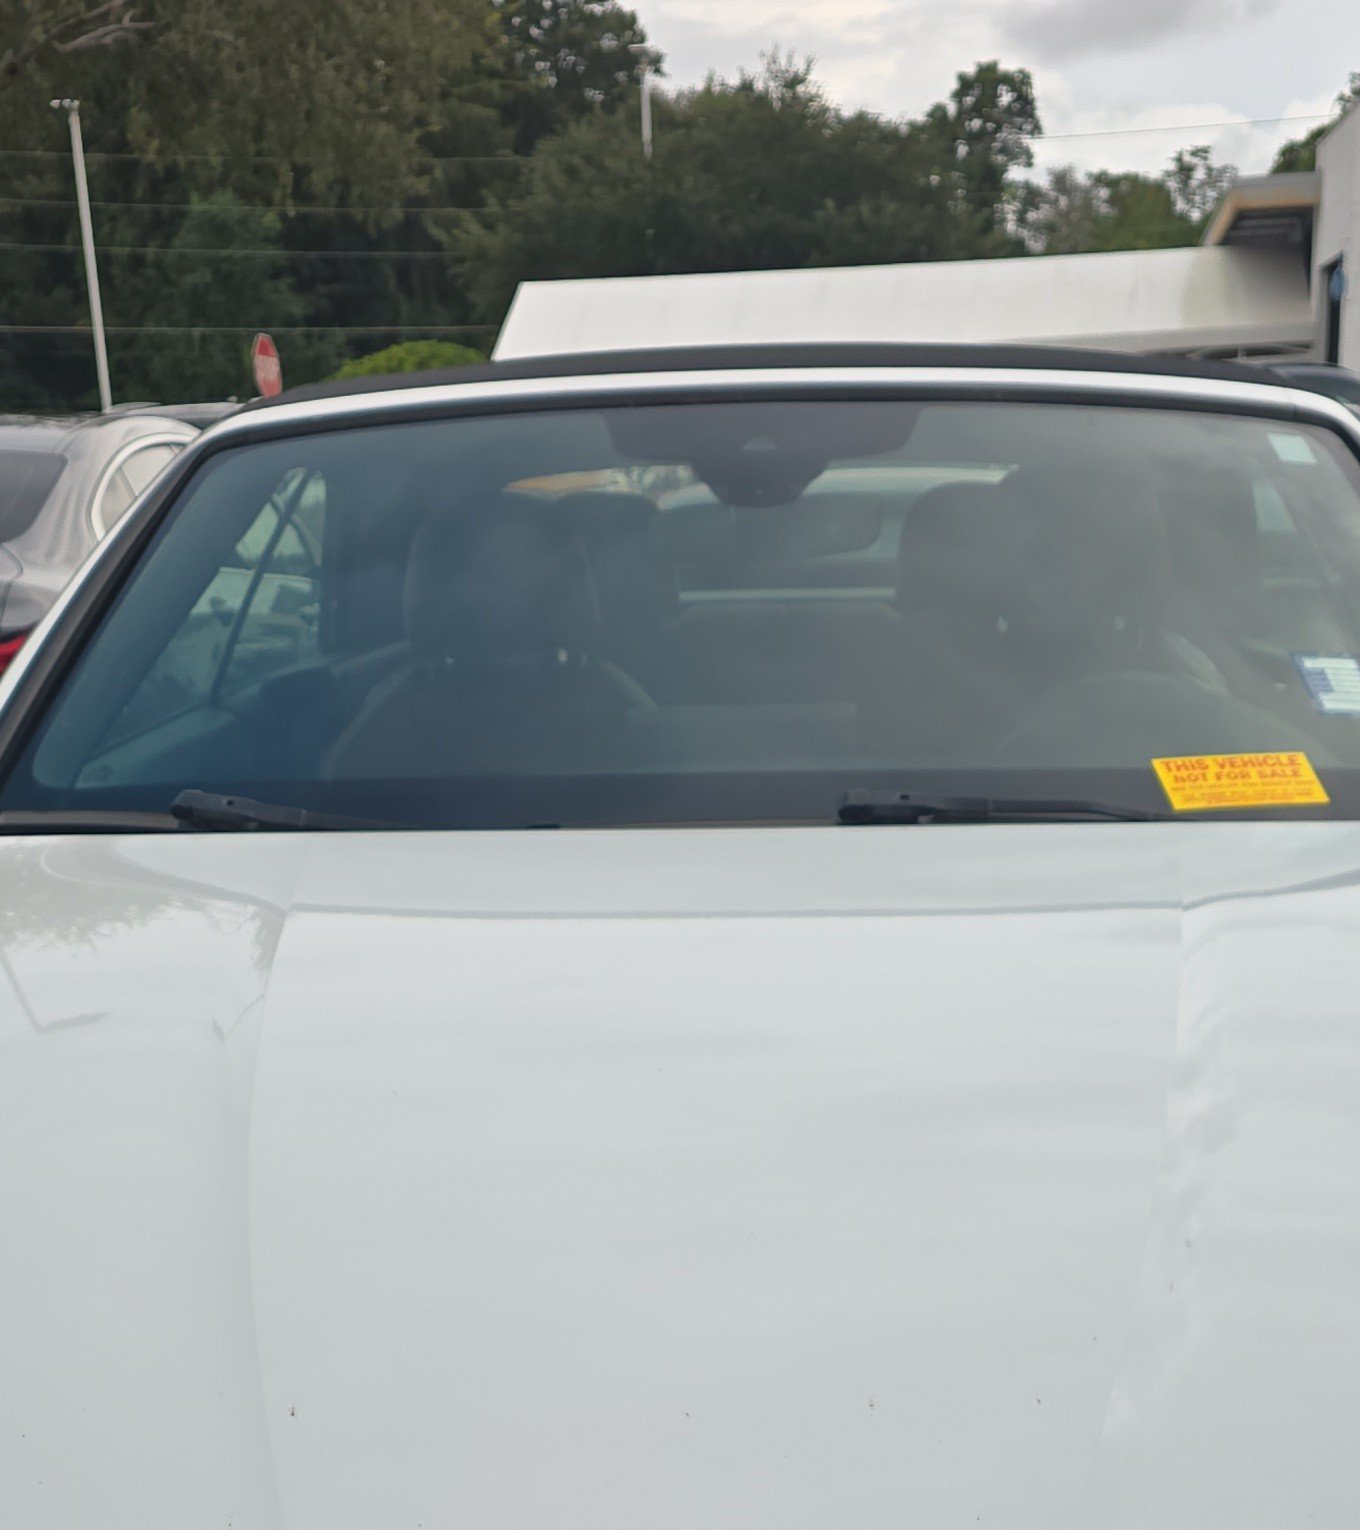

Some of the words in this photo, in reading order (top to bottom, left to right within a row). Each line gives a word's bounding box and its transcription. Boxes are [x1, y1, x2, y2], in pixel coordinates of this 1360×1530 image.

[1162, 759, 1209, 772] THIS
[1212, 754, 1301, 769] VEHICLE
[1173, 772, 1209, 783] NOT
[1215, 769, 1251, 781] FOR
[1257, 768, 1303, 779] SALE
